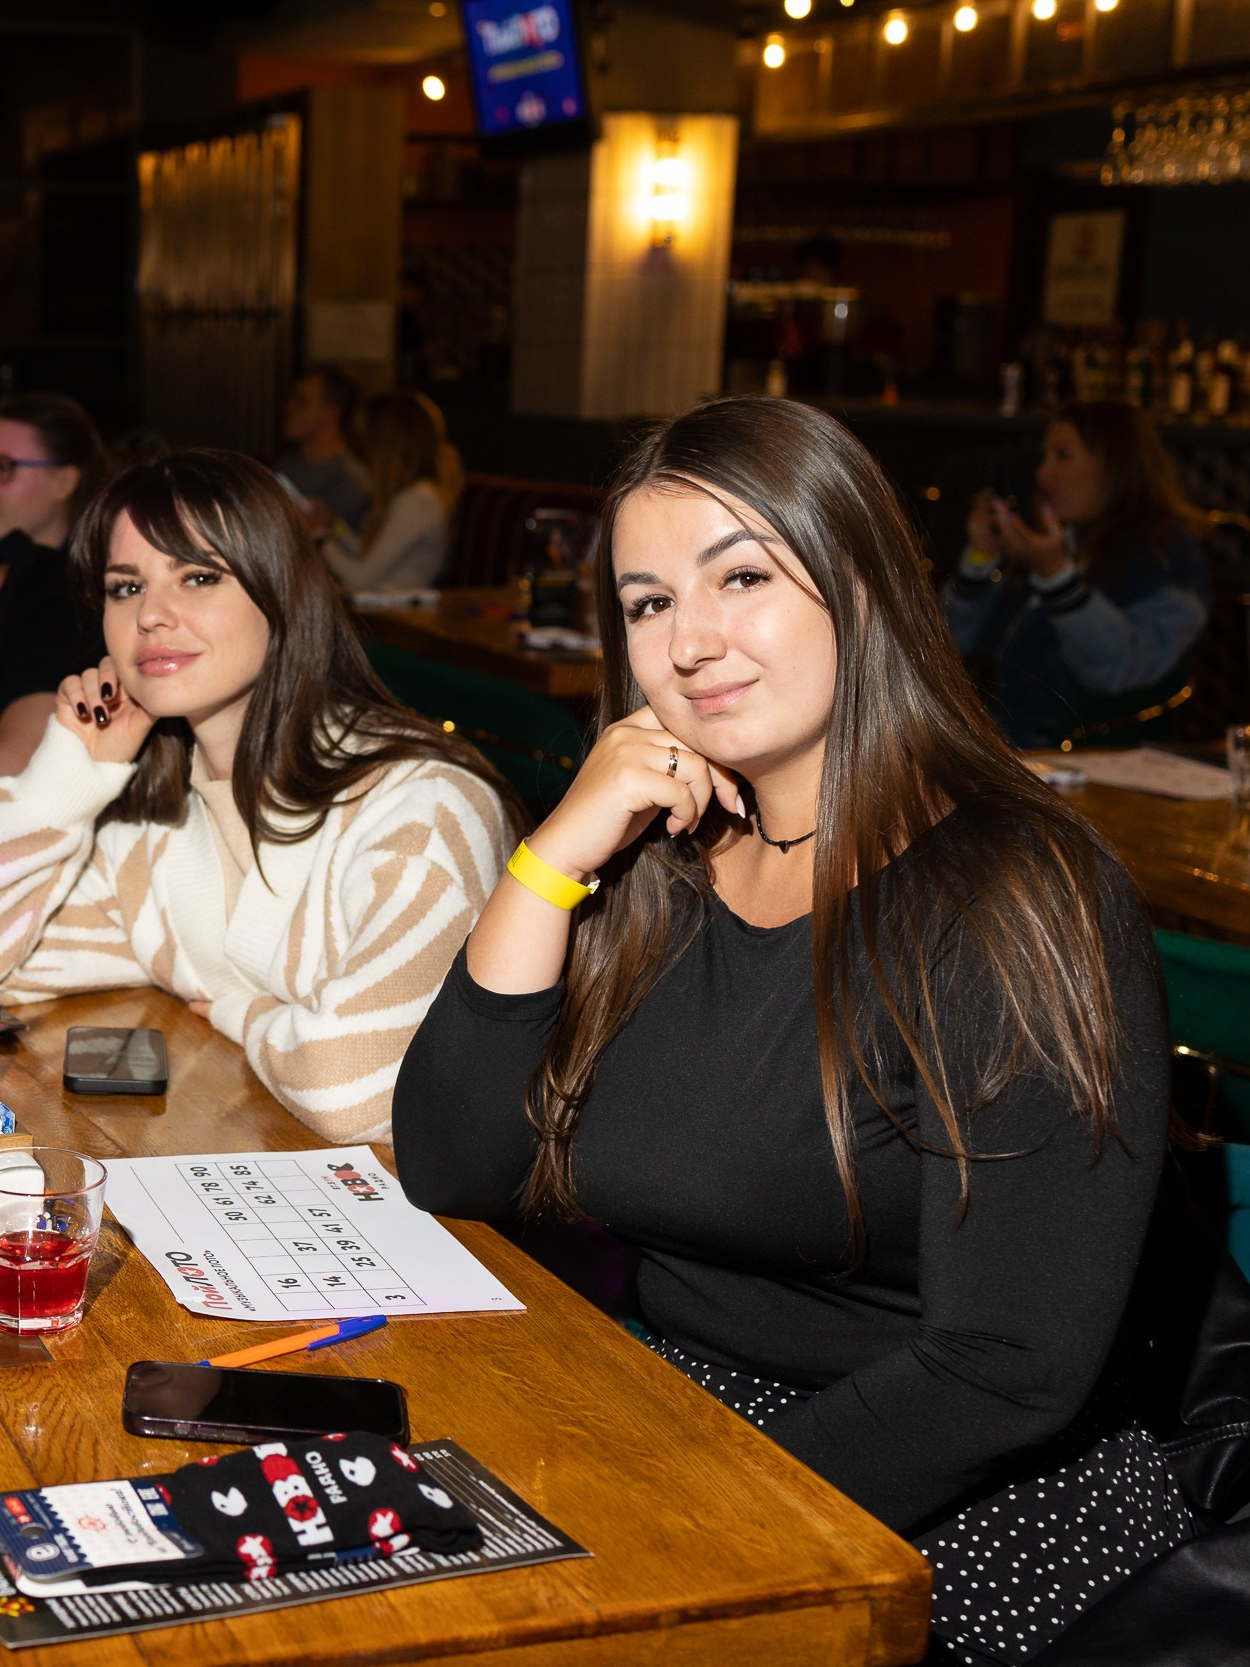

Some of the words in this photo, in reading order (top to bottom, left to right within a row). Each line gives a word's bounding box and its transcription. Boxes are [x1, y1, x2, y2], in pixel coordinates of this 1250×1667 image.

[190, 1166, 211, 1177] 90
[229, 1165, 252, 1176] 85
[201, 1182, 223, 1192] 78
[242, 1180, 264, 1190] 74
[212, 1197, 234, 1206] 61
[254, 1195, 276, 1204] 62
[224, 1211, 248, 1221] 50
[307, 1208, 331, 1217] 57
[321, 1223, 343, 1233] 41
[292, 1241, 317, 1251] 37
[336, 1240, 361, 1250] 39
[350, 1256, 376, 1267] 25
[277, 1278, 301, 1289] 16
[322, 1275, 346, 1287] 14
